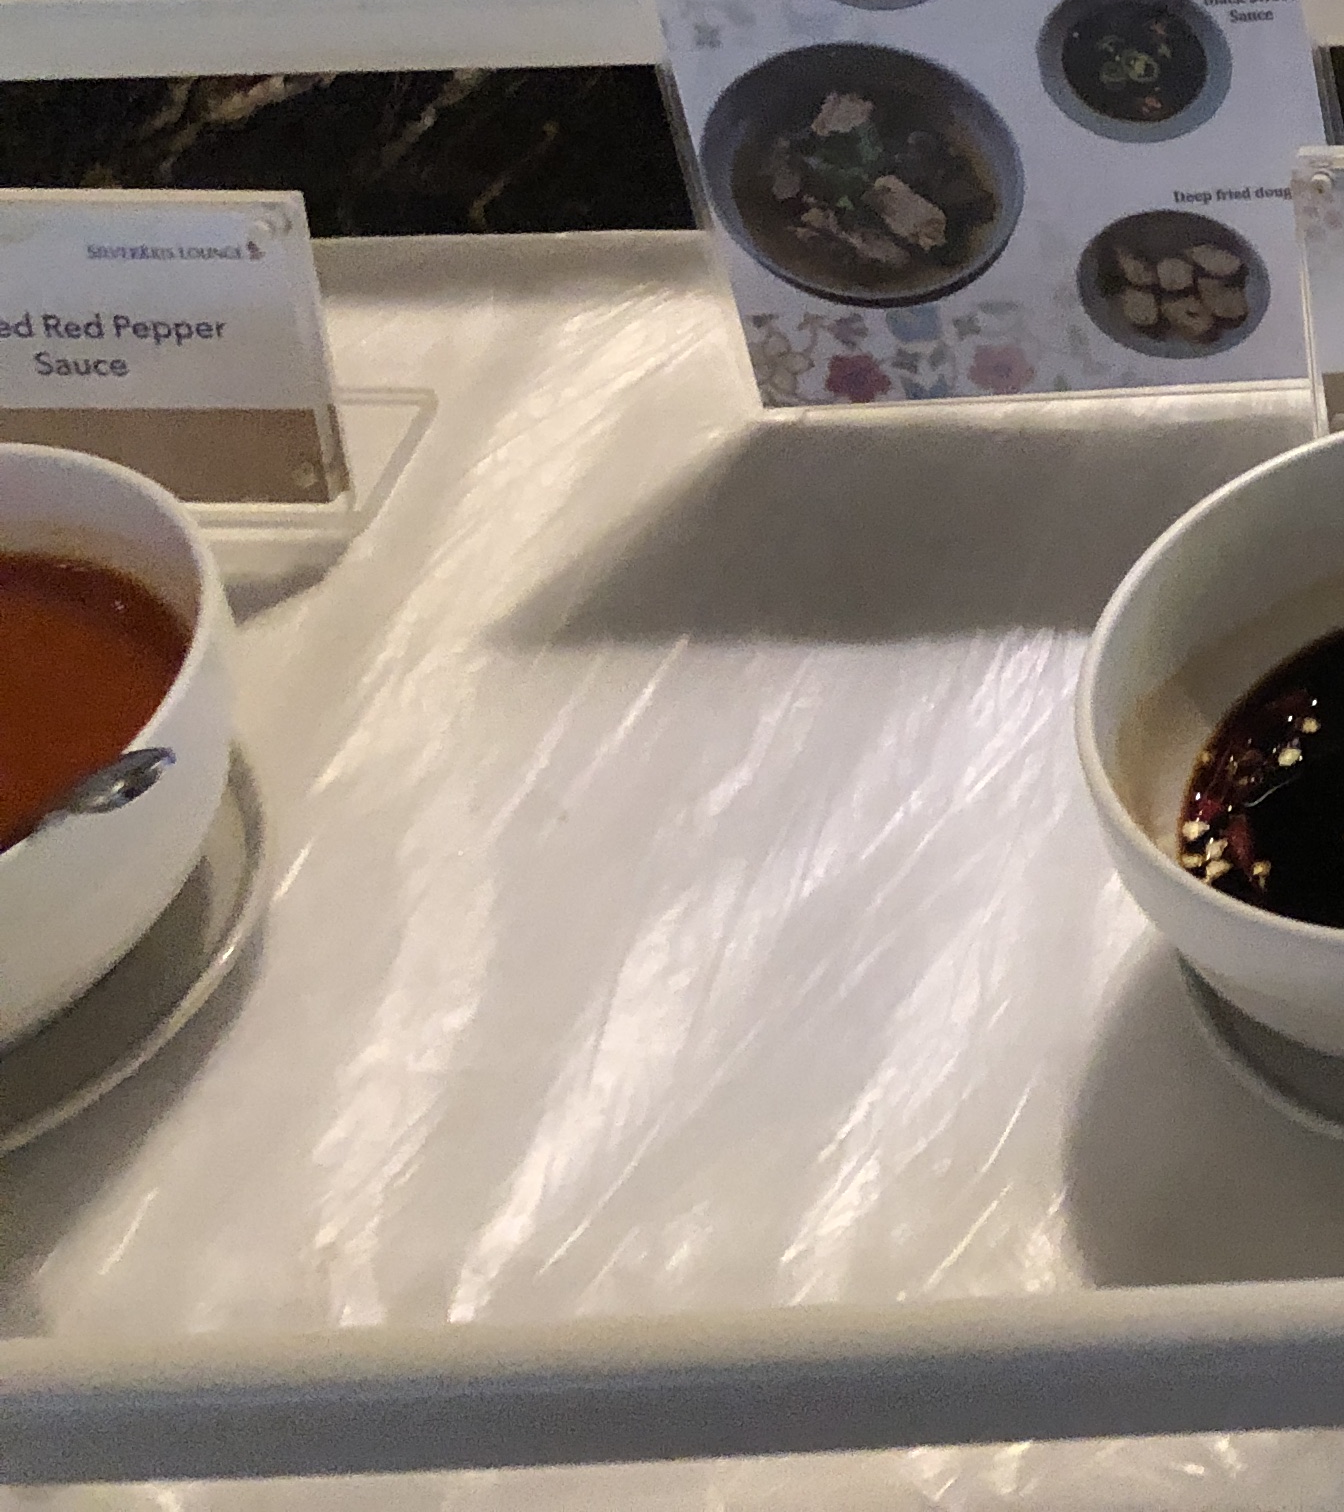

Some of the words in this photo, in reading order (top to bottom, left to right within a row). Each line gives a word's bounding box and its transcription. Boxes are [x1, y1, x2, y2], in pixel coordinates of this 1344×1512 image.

[1230, 9, 1273, 23] Sauce
[1173, 189, 1213, 205] Deep
[1216, 187, 1251, 201] fried
[42, 313, 104, 339] Red
[113, 313, 227, 346] Pepper
[33, 350, 129, 376] Sauce
